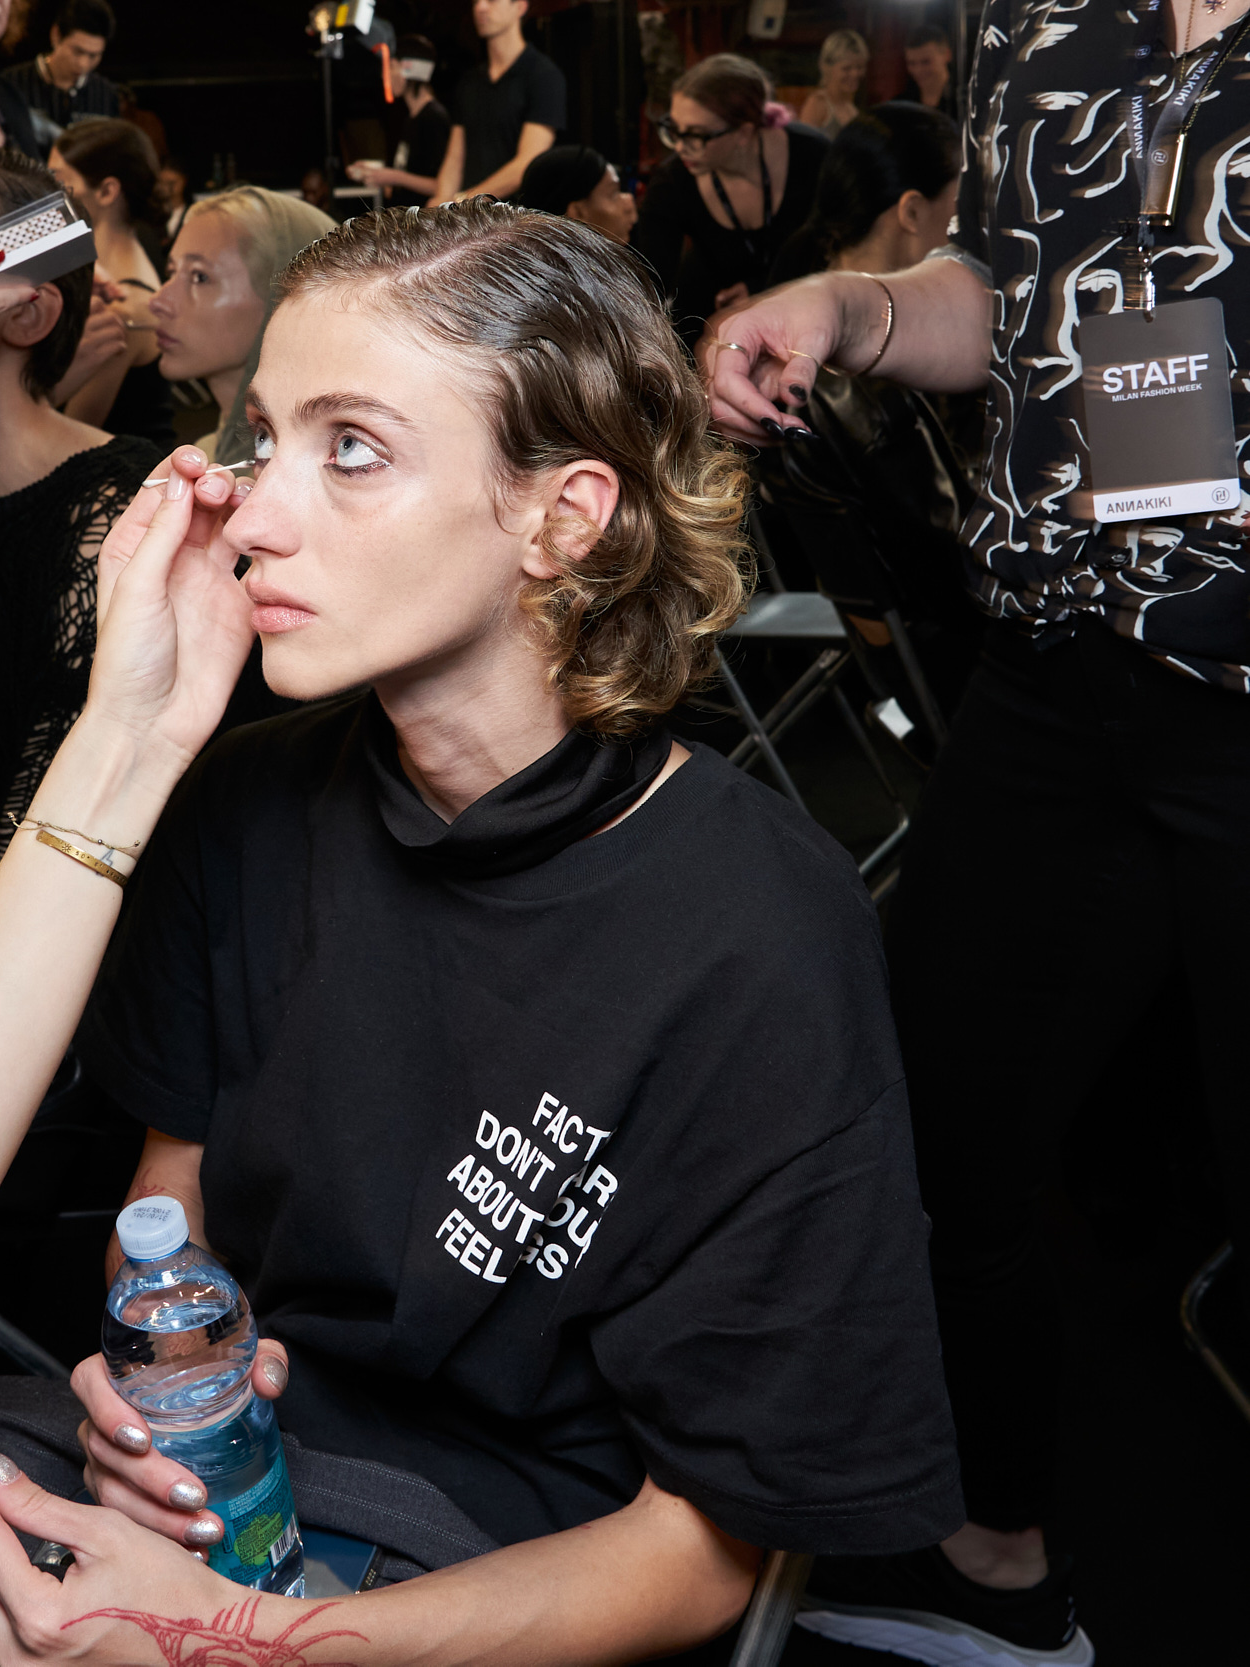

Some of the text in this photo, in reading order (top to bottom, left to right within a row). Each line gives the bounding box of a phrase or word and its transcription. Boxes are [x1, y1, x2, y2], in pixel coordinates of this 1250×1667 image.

[1102, 353, 1209, 394] STAFF
[1112, 383, 1203, 403] MILAN FASHION WEEK
[475, 1109, 556, 1192] DON'T
[446, 1154, 545, 1244] ABOUT
